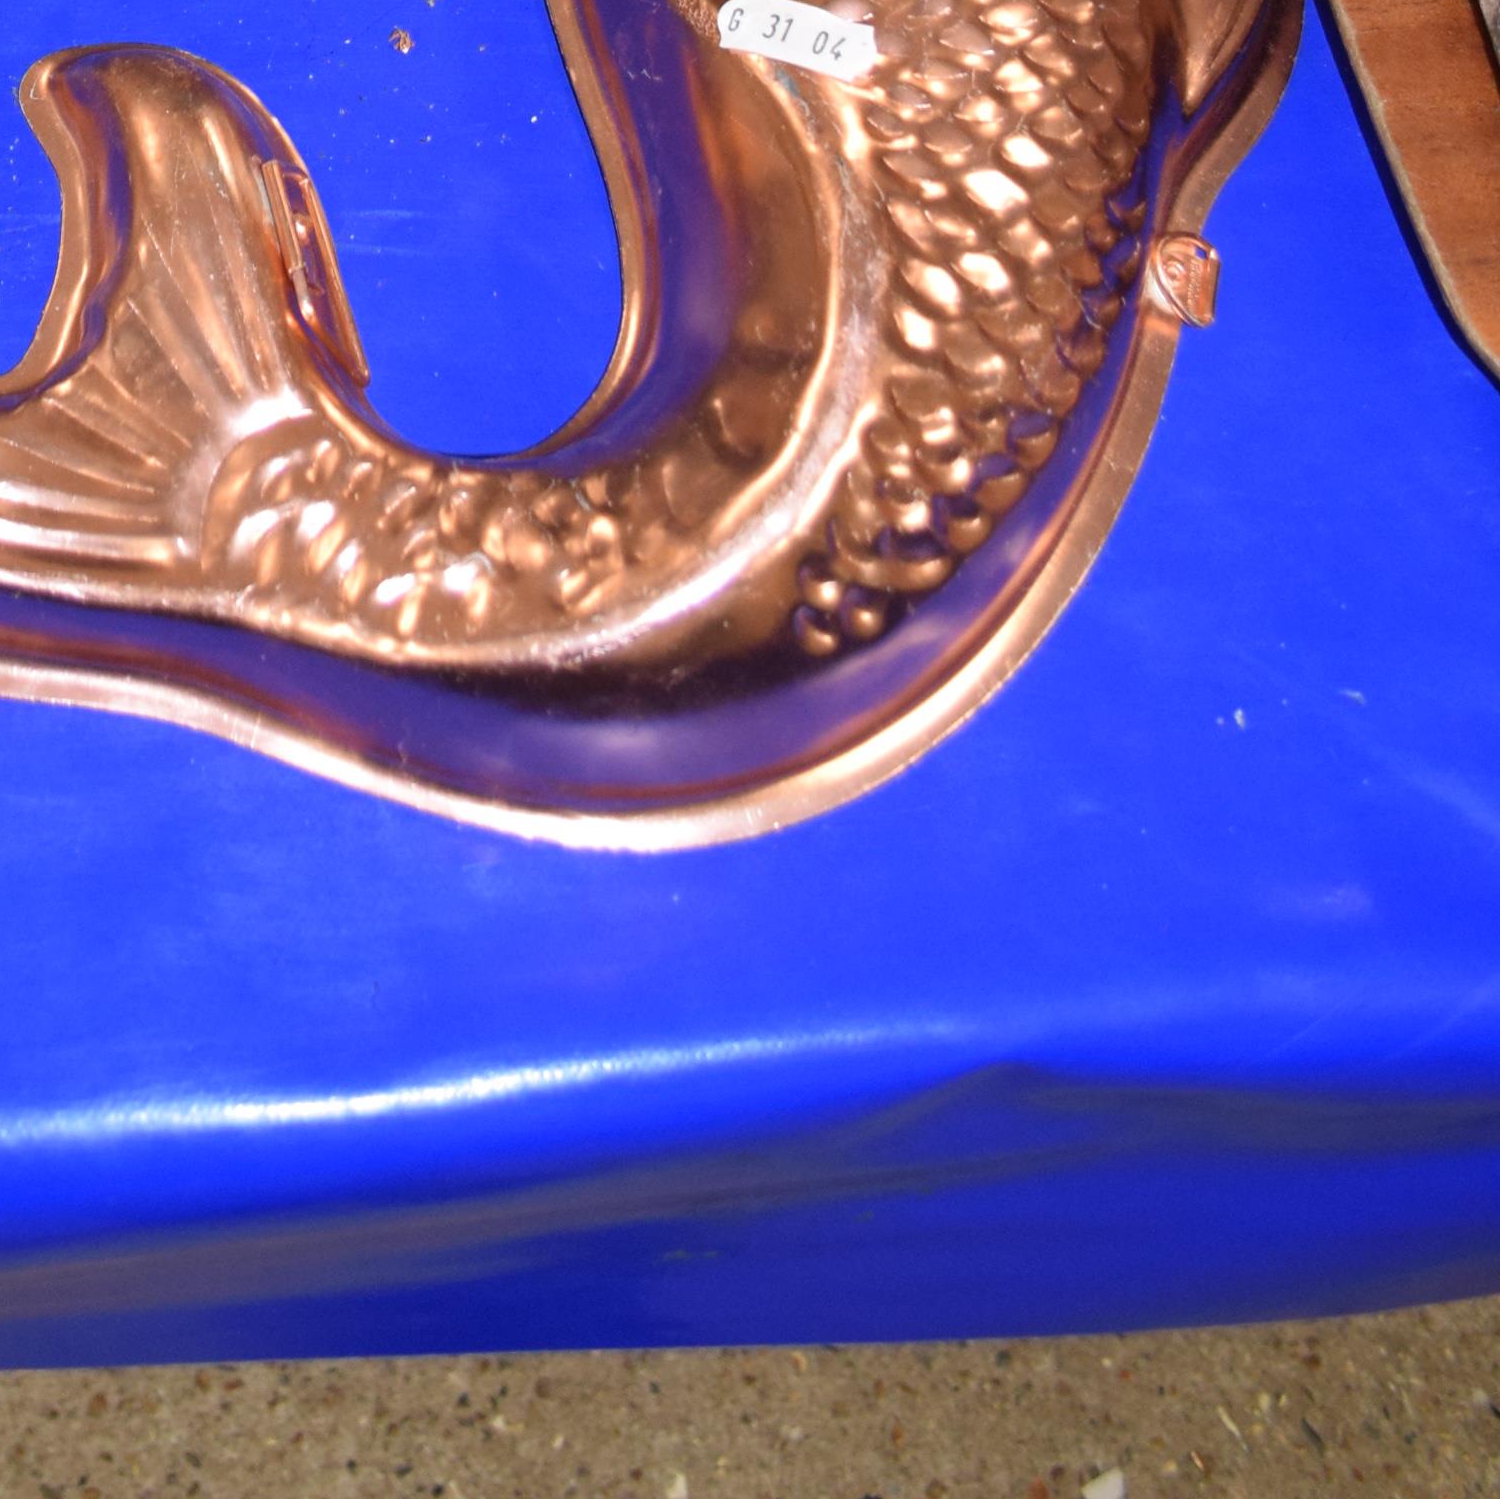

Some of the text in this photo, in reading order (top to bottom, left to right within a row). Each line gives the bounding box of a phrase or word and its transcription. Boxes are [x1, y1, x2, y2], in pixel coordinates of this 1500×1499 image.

[728, 7, 846, 61] G 31 04
